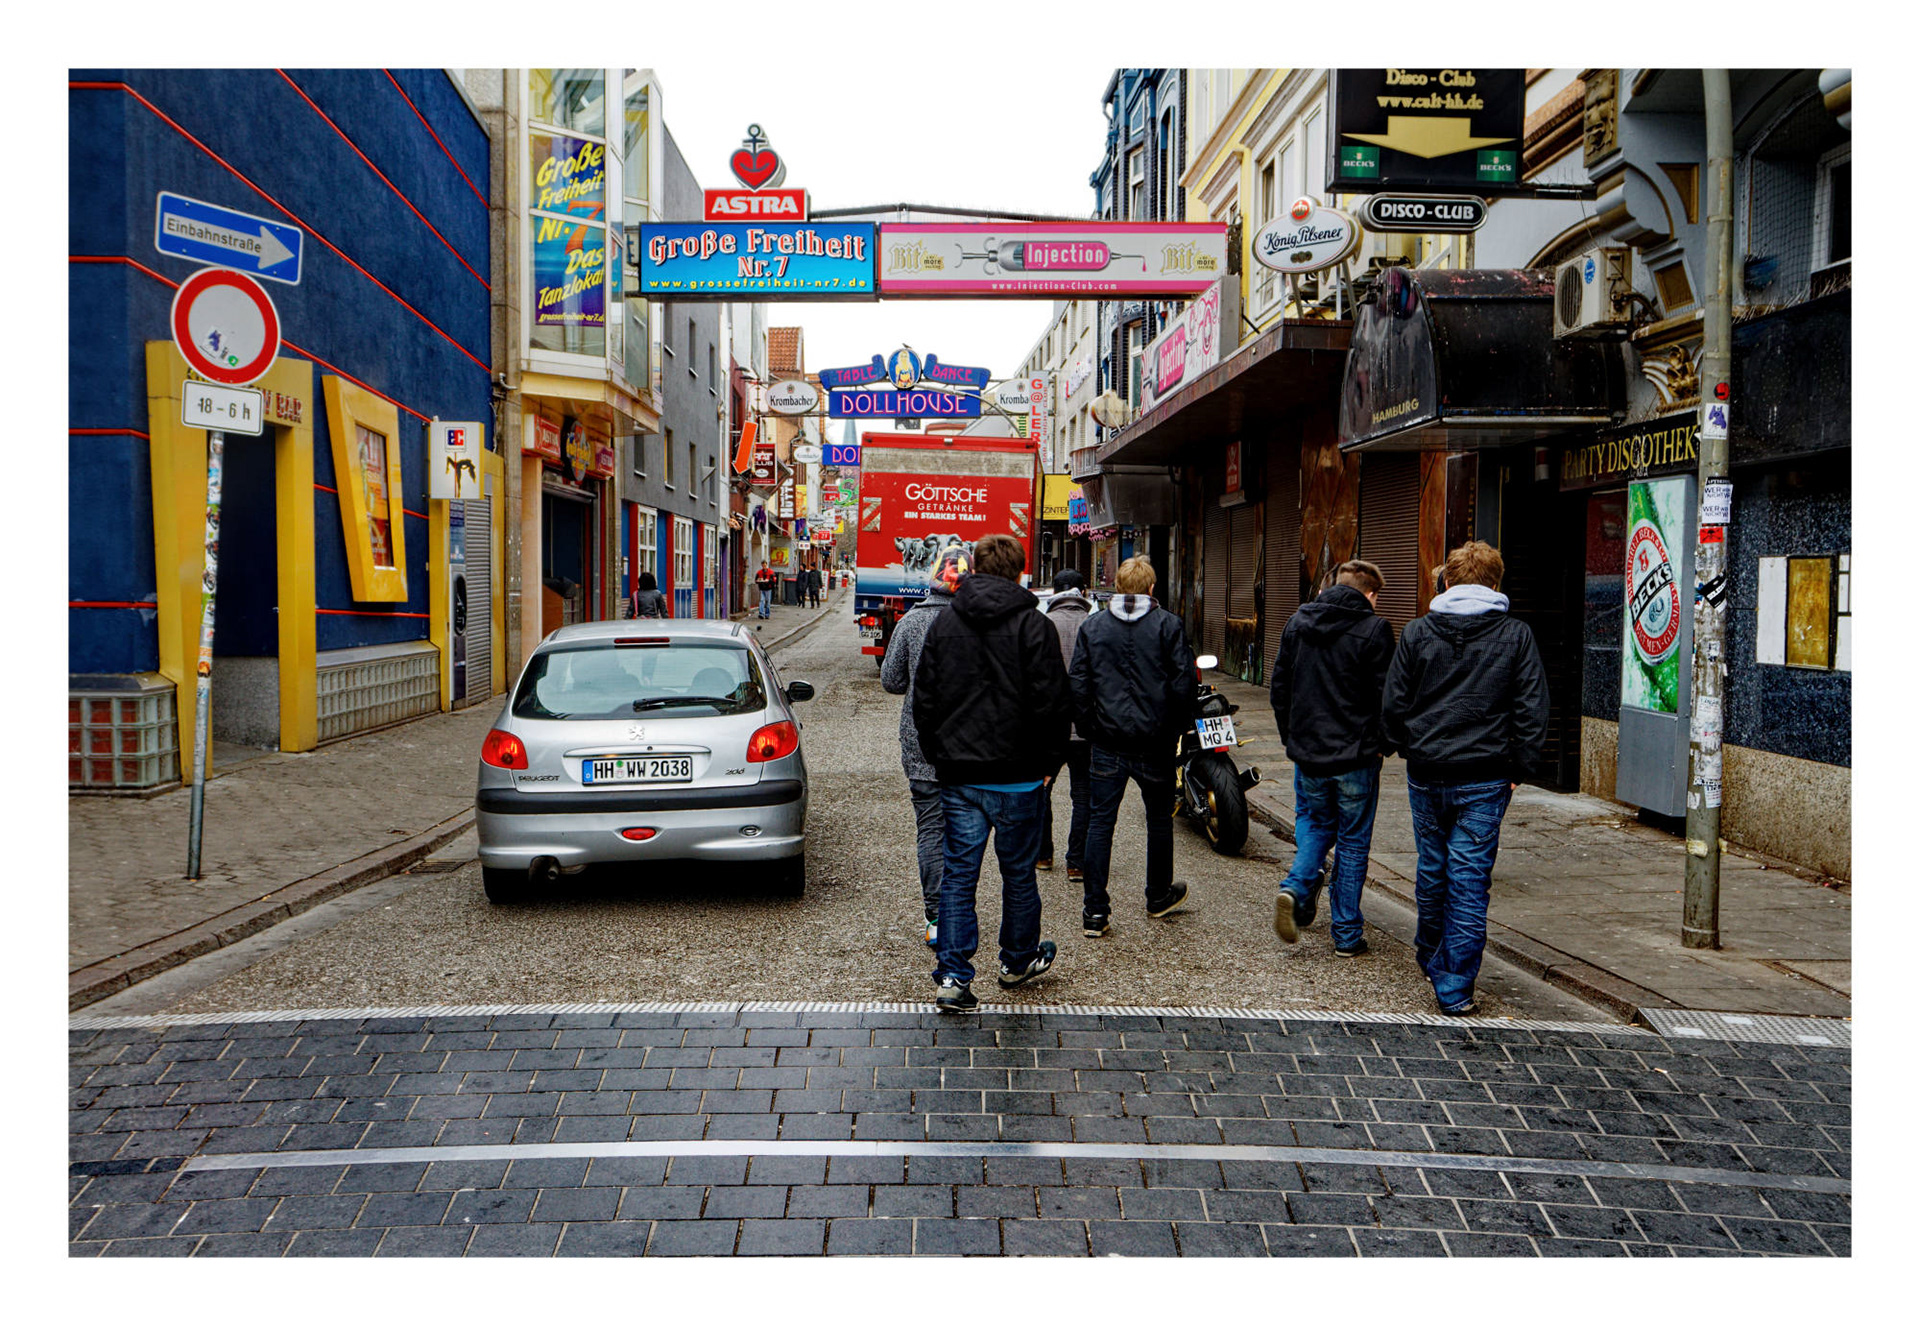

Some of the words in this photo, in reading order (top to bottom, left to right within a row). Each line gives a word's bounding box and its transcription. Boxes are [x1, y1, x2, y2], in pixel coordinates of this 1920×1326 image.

[1386, 69, 1428, 85] Disco
[1439, 70, 1476, 87] Club
[536, 142, 605, 187] Große
[1343, 159, 1375, 168] BECK'S
[1480, 164, 1512, 172] BECK'S
[537, 169, 605, 210] Freiheit
[711, 196, 799, 214] ASTRA
[166, 217, 262, 254] Einbahnstraße
[564, 199, 604, 255] 7
[1264, 231, 1297, 250] König
[1298, 225, 1344, 245] Pilsener
[649, 230, 736, 266] Große
[746, 228, 866, 261] Freiheit
[1028, 243, 1104, 268] Injection
[565, 248, 604, 274] Das
[538, 267, 605, 309] Tanzlokal
[650, 278, 867, 290] www.grossefreiheit-nr7.de
[1160, 335, 1185, 387] Injection
[836, 366, 877, 383] TABLE
[932, 365, 973, 382] DANCE
[197, 397, 213, 414] 18
[229, 402, 237, 418] 6
[243, 402, 251, 420] h
[770, 395, 814, 406] Krombacher
[841, 393, 968, 414] DOLLHOUSE
[1030, 379, 1043, 448] G@LER
[1372, 398, 1420, 425] HAMBURG
[1564, 444, 1606, 480] PARTY
[1607, 425, 1698, 473] DISCOTHEK
[905, 483, 988, 503] GÖTTSCHE
[904, 511, 918, 519] EIN
[920, 512, 957, 521] STARKES
[917, 503, 974, 513] GETRÄNKE
[1204, 718, 1224, 732] HH
[1203, 733, 1222, 746] MQ
[1225, 732, 1233, 744] 4
[593, 760, 614, 779] HH
[626, 760, 647, 778] WW
[650, 760, 690, 777] 2038
[725, 768, 745, 776] 206
